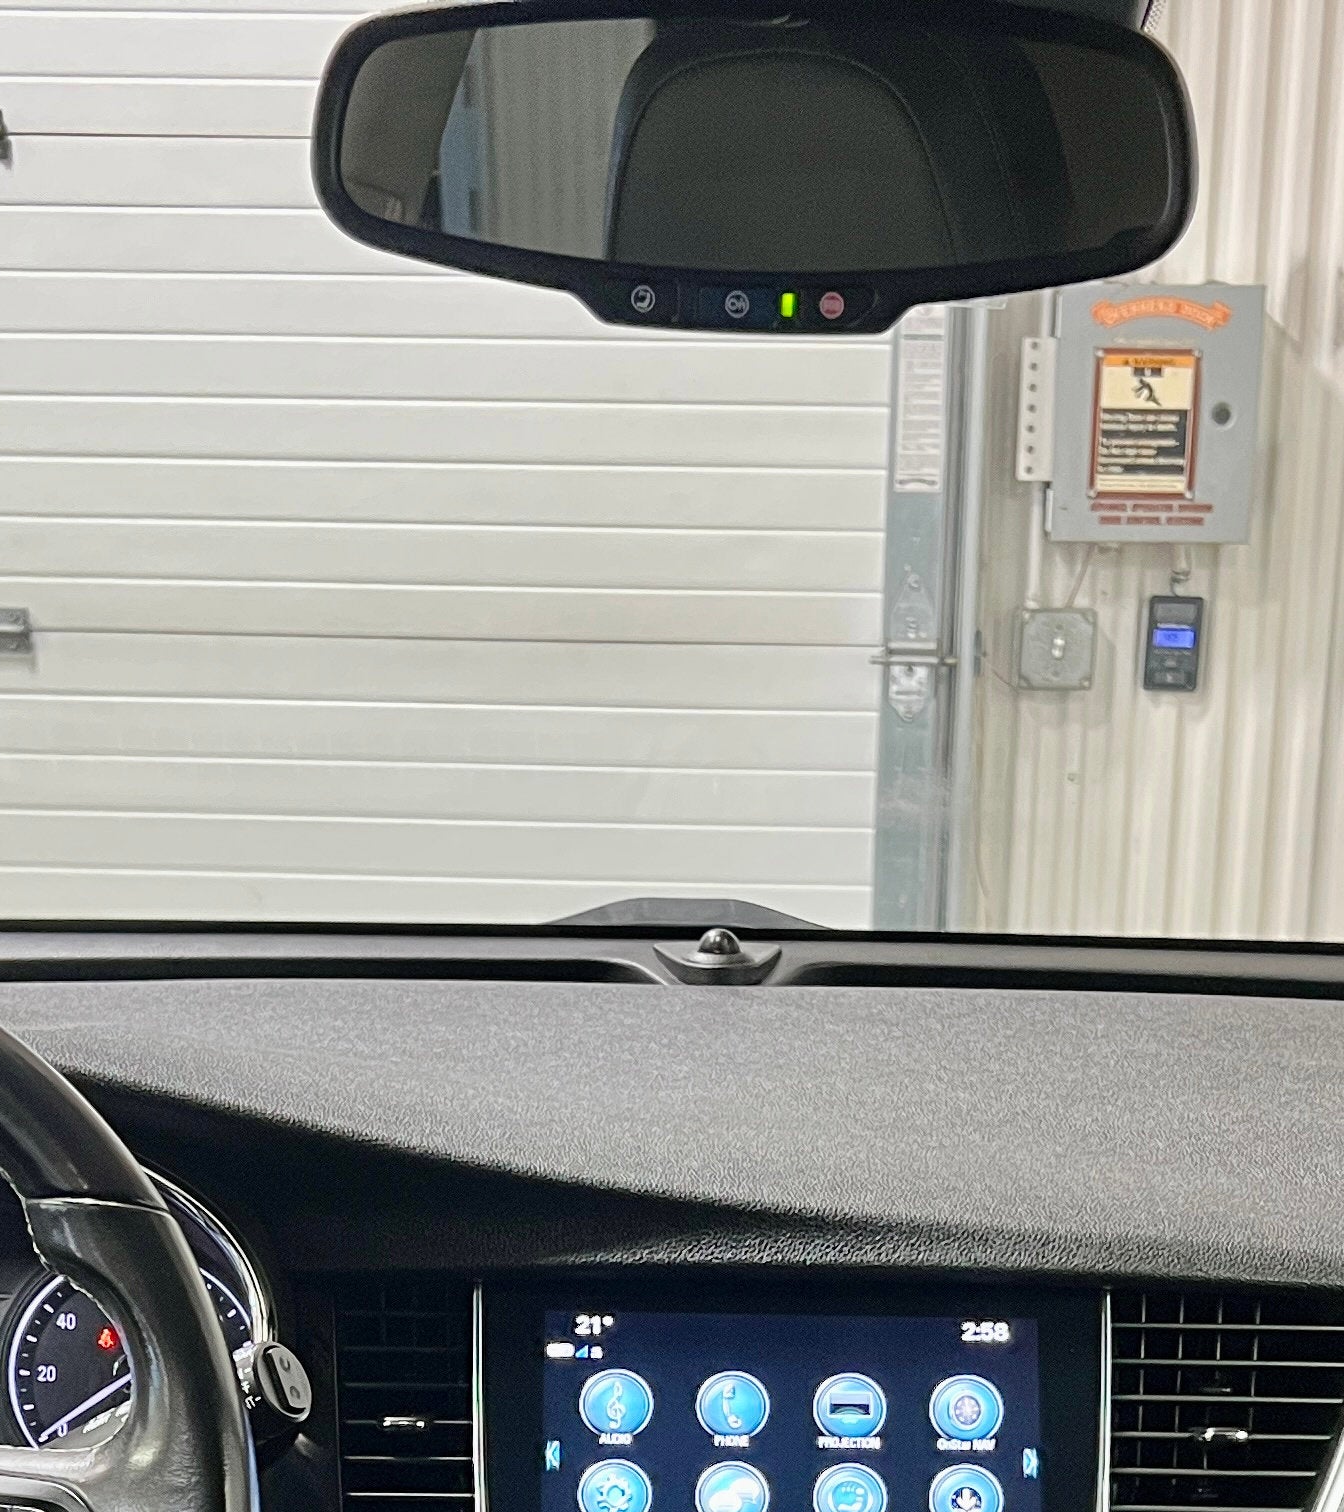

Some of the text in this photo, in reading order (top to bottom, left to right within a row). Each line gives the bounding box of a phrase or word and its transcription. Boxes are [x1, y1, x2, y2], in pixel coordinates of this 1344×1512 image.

[56, 1312, 76, 1330] 40
[960, 1320, 1010, 1342] 2:58
[36, 1365, 57, 1383] 20
[56, 1422, 68, 1437] 0
[713, 1435, 750, 1448] PHONE
